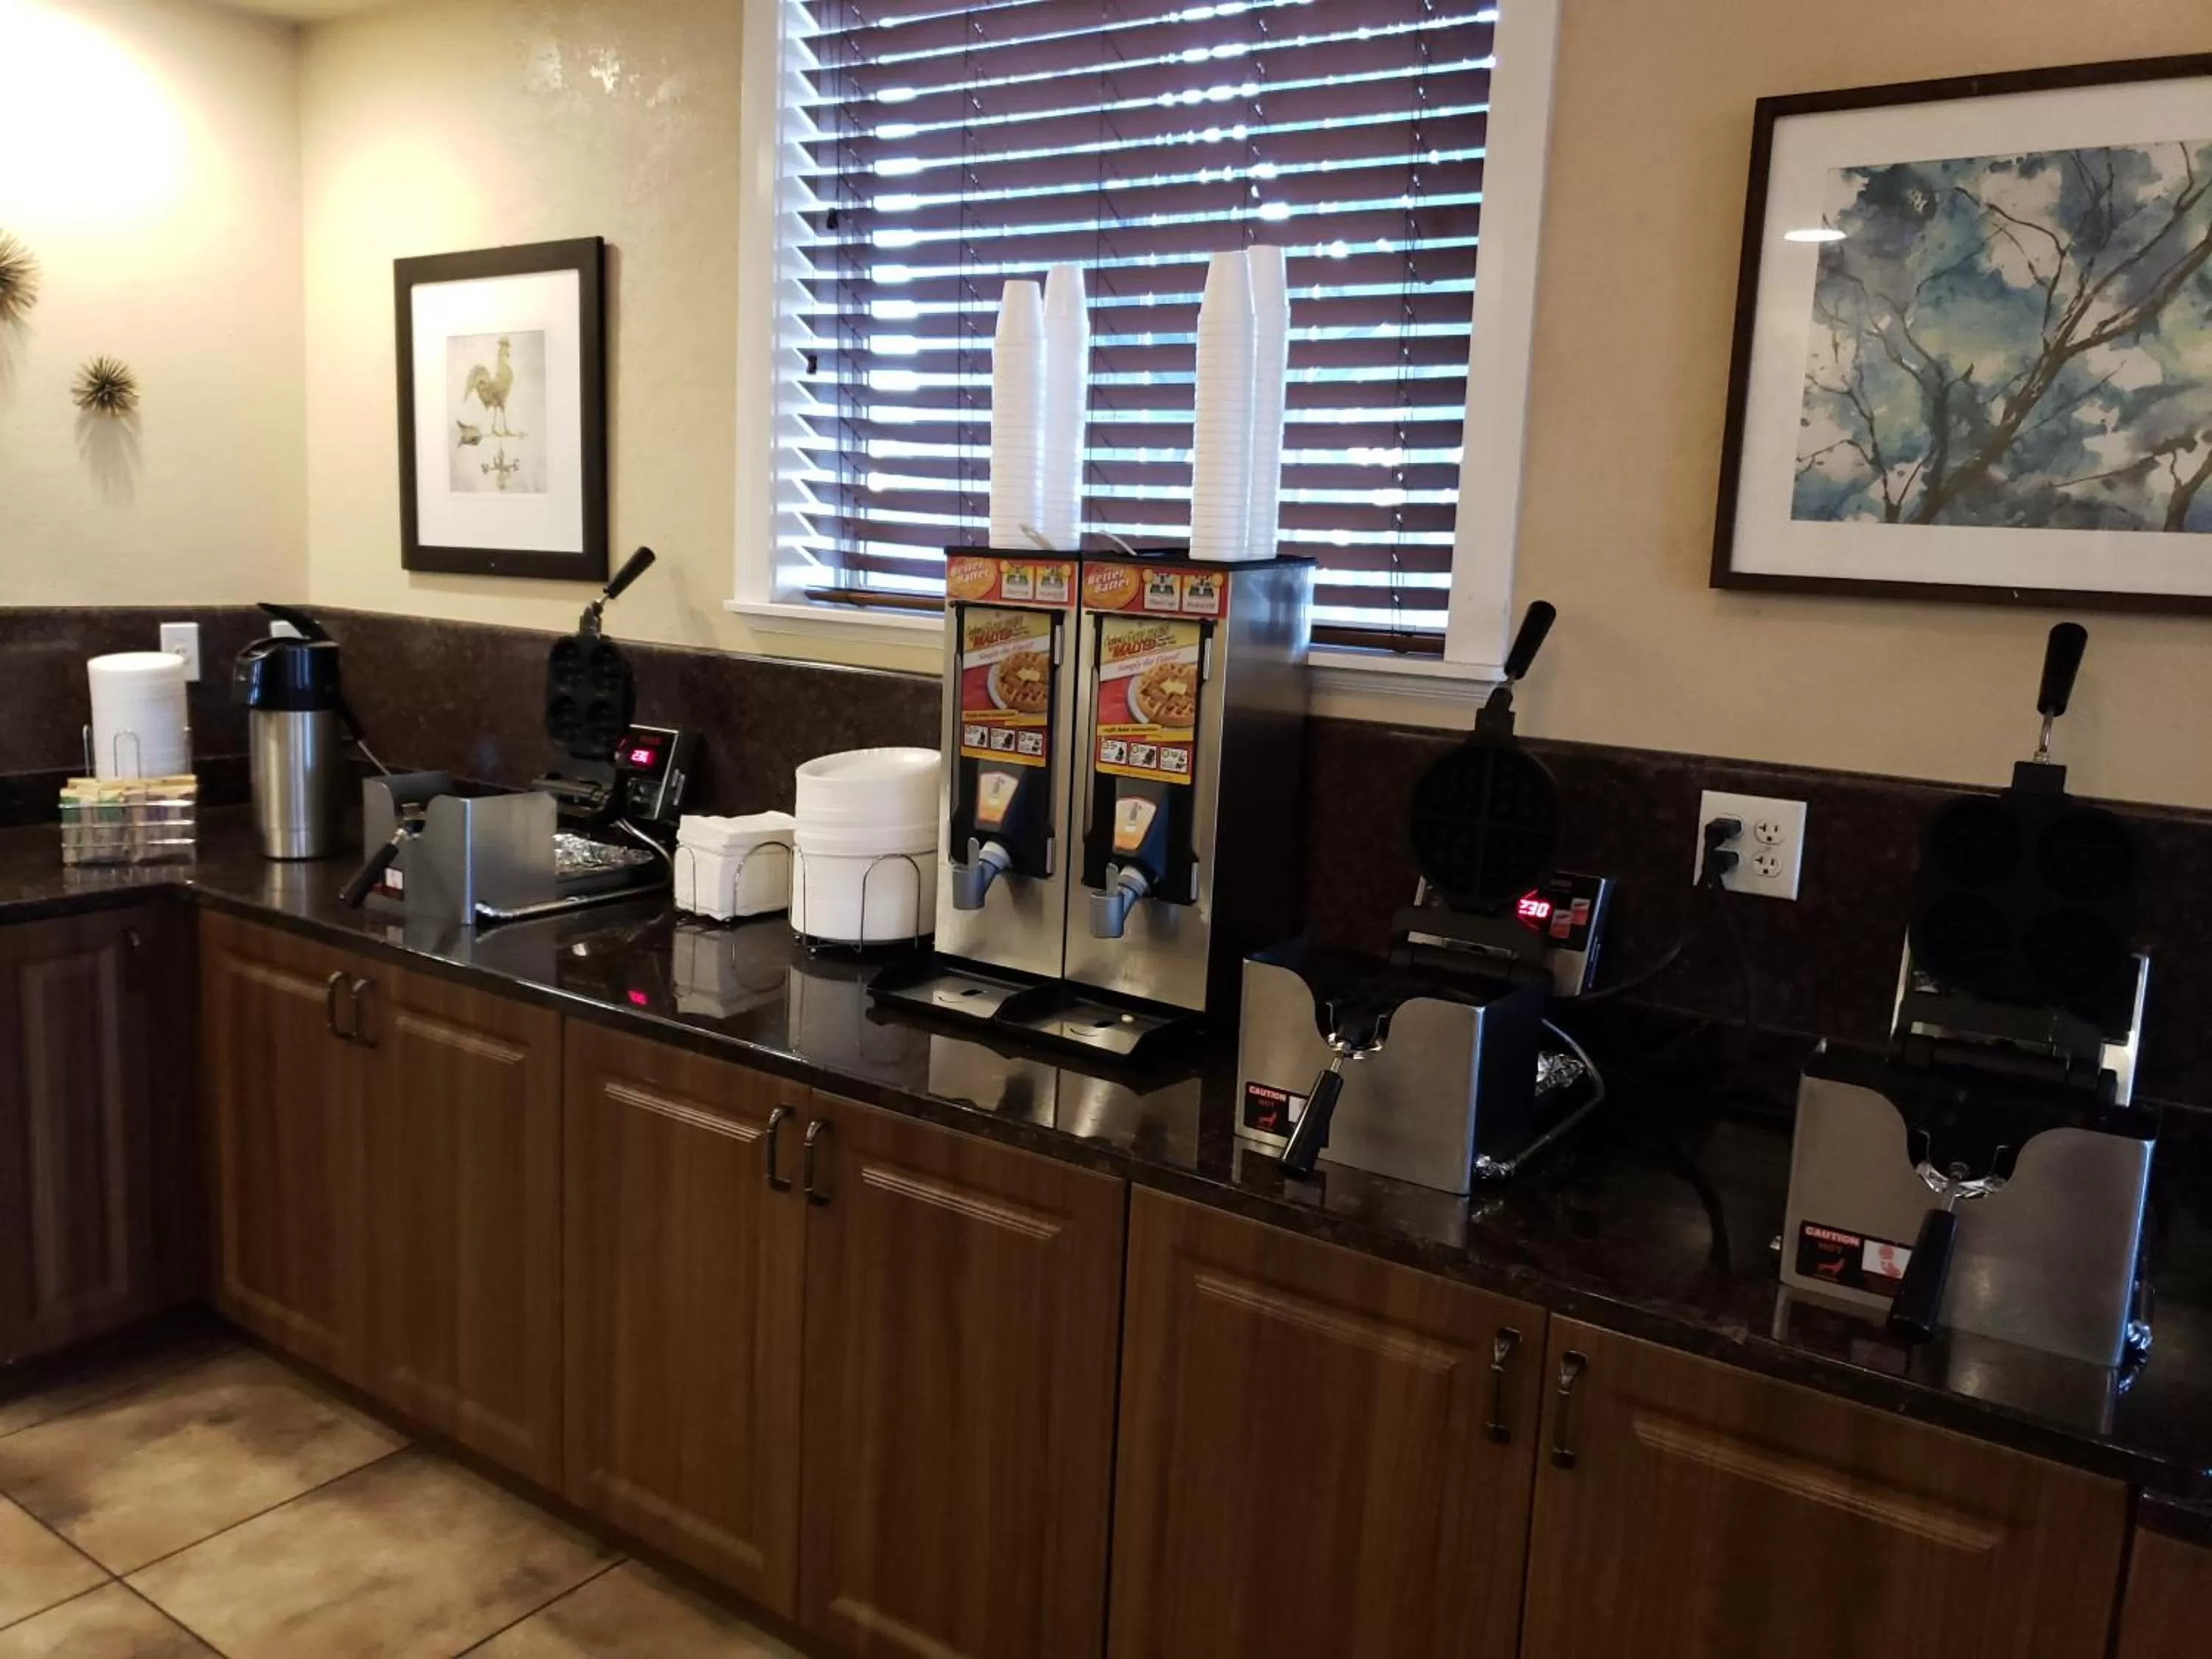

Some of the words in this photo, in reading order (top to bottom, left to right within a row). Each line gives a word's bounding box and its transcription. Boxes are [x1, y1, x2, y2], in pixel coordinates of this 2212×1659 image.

[1088, 569, 1124, 585] Better
[1519, 899, 1550, 917] 230
[1248, 1085, 1287, 1102] CAUTION
[1805, 1225, 1861, 1247] CAUTION
